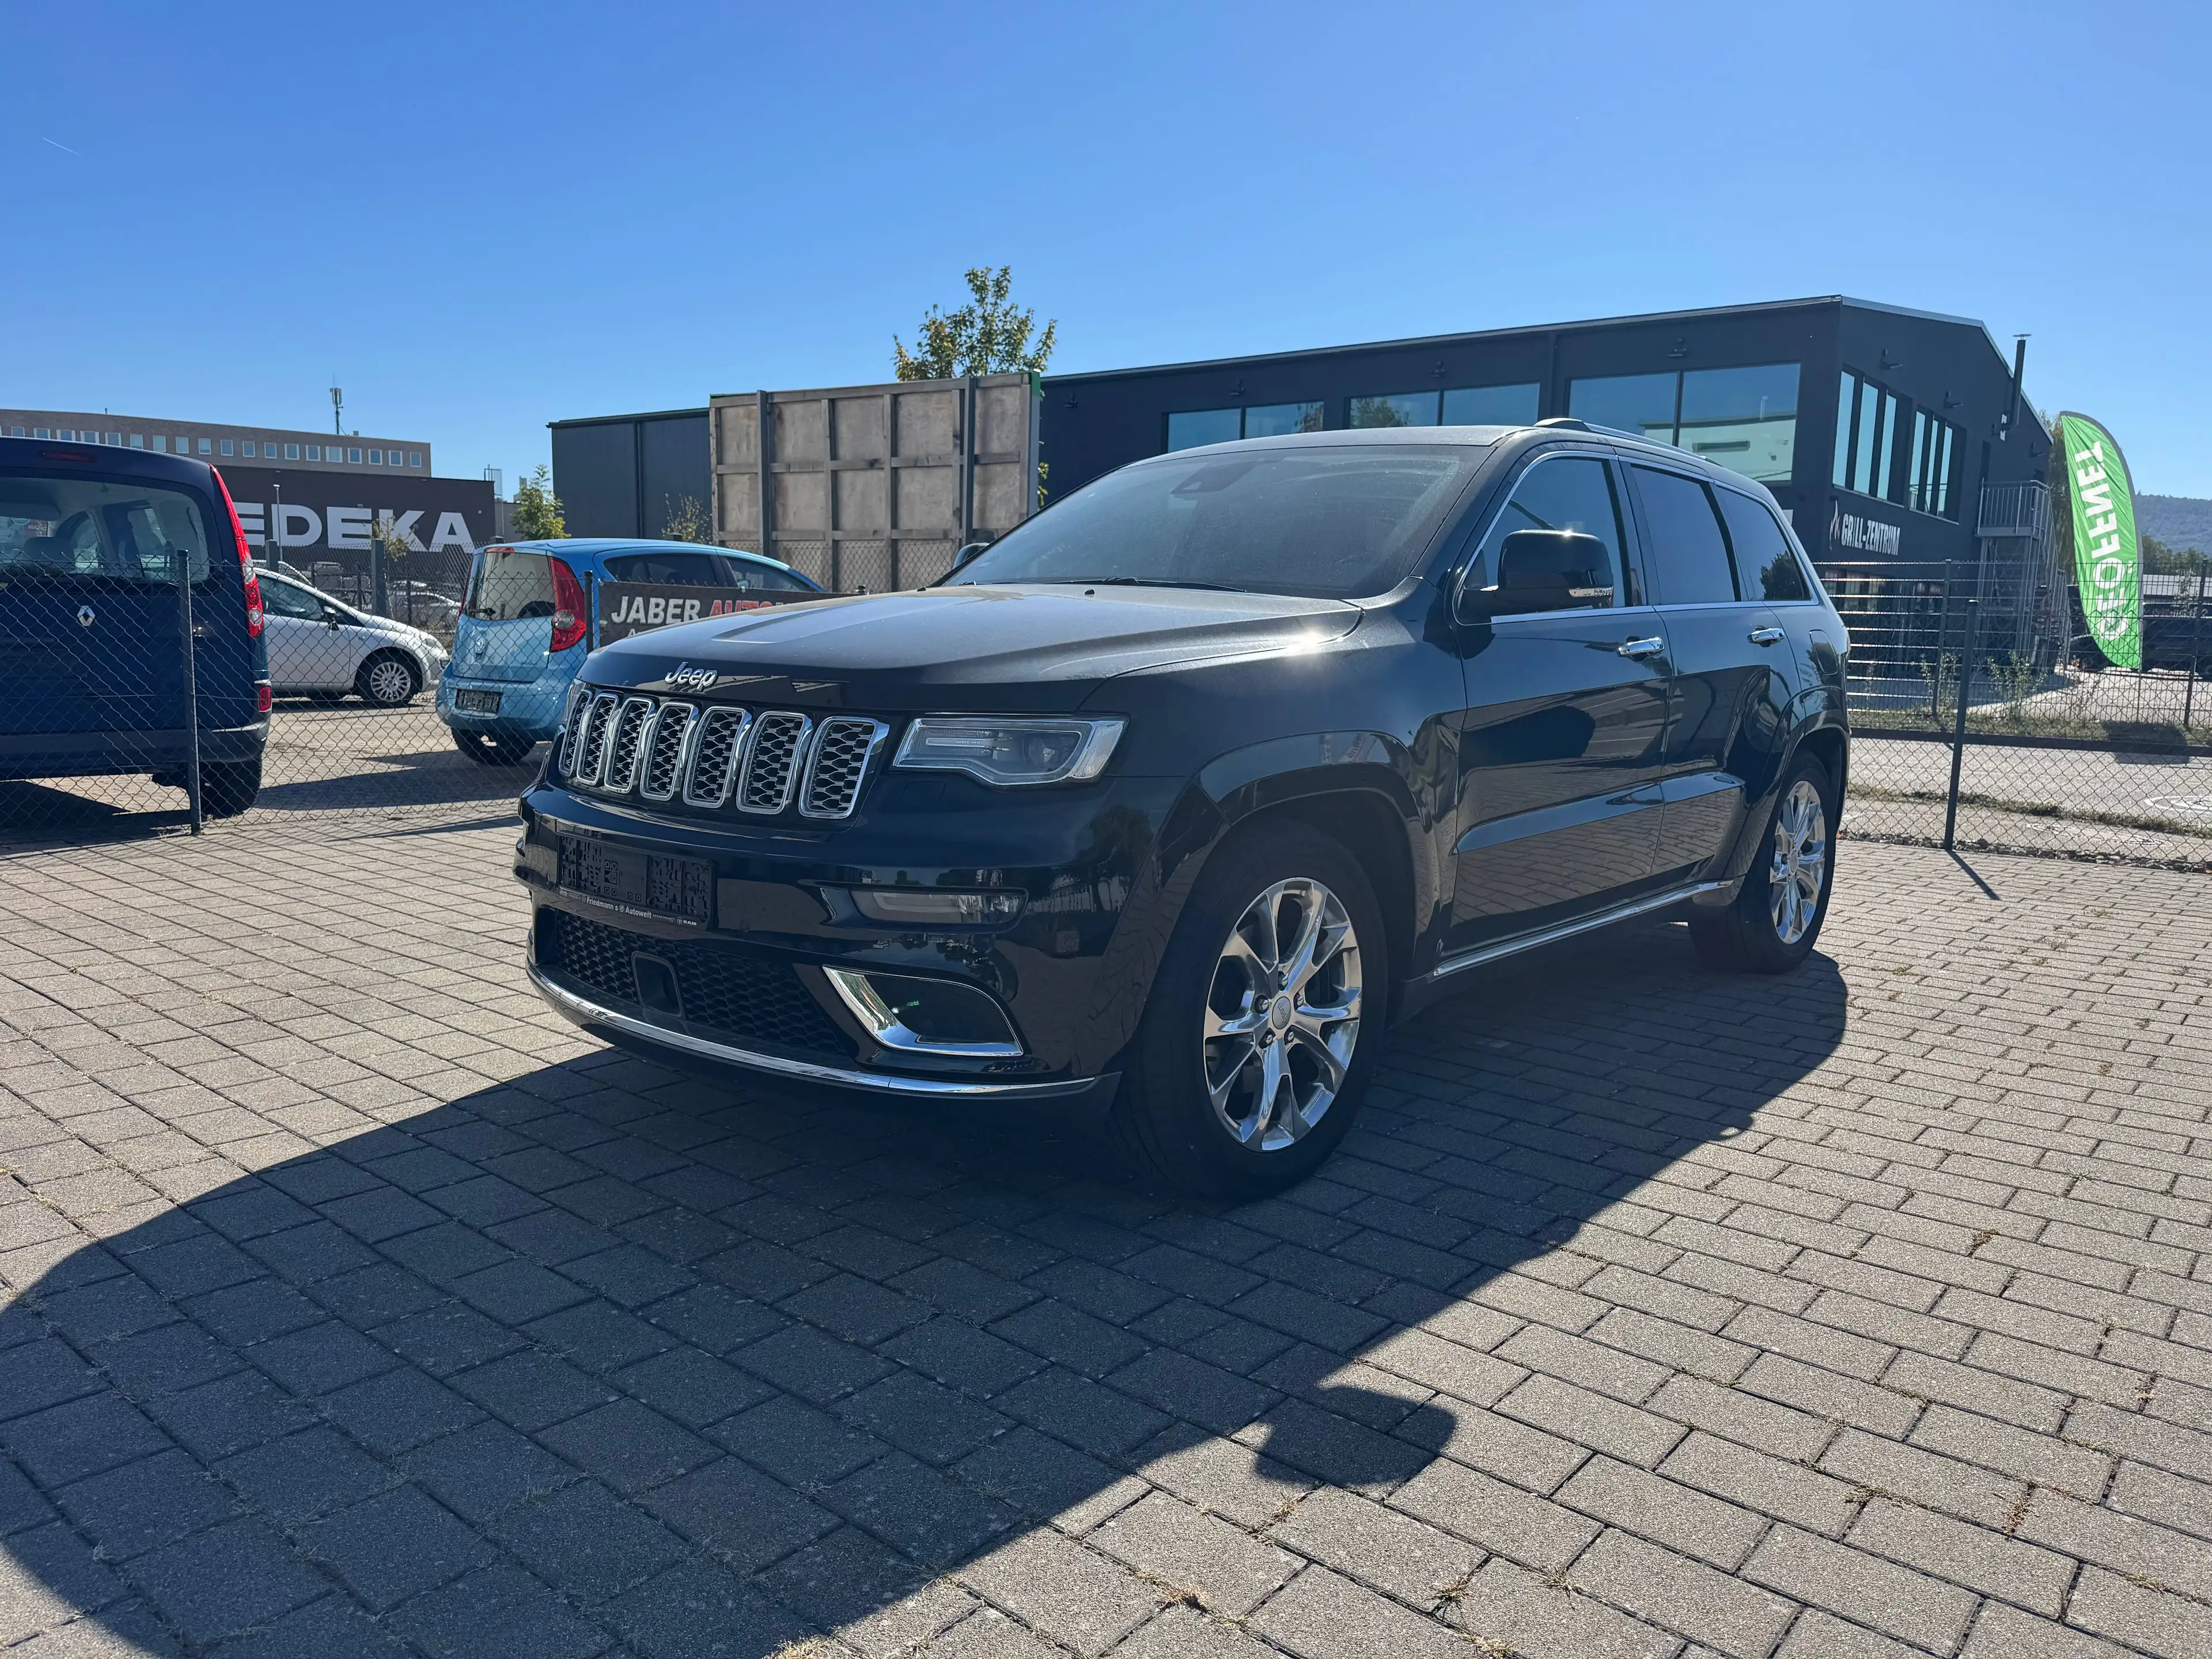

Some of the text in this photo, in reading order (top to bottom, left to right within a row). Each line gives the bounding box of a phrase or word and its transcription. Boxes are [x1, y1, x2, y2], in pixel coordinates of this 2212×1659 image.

[1842, 513, 1900, 555] GRILL-ZENTRUM
[611, 596, 701, 624] JABER
[665, 661, 718, 692] Jeep
[625, 906, 652, 919] Autowelt
